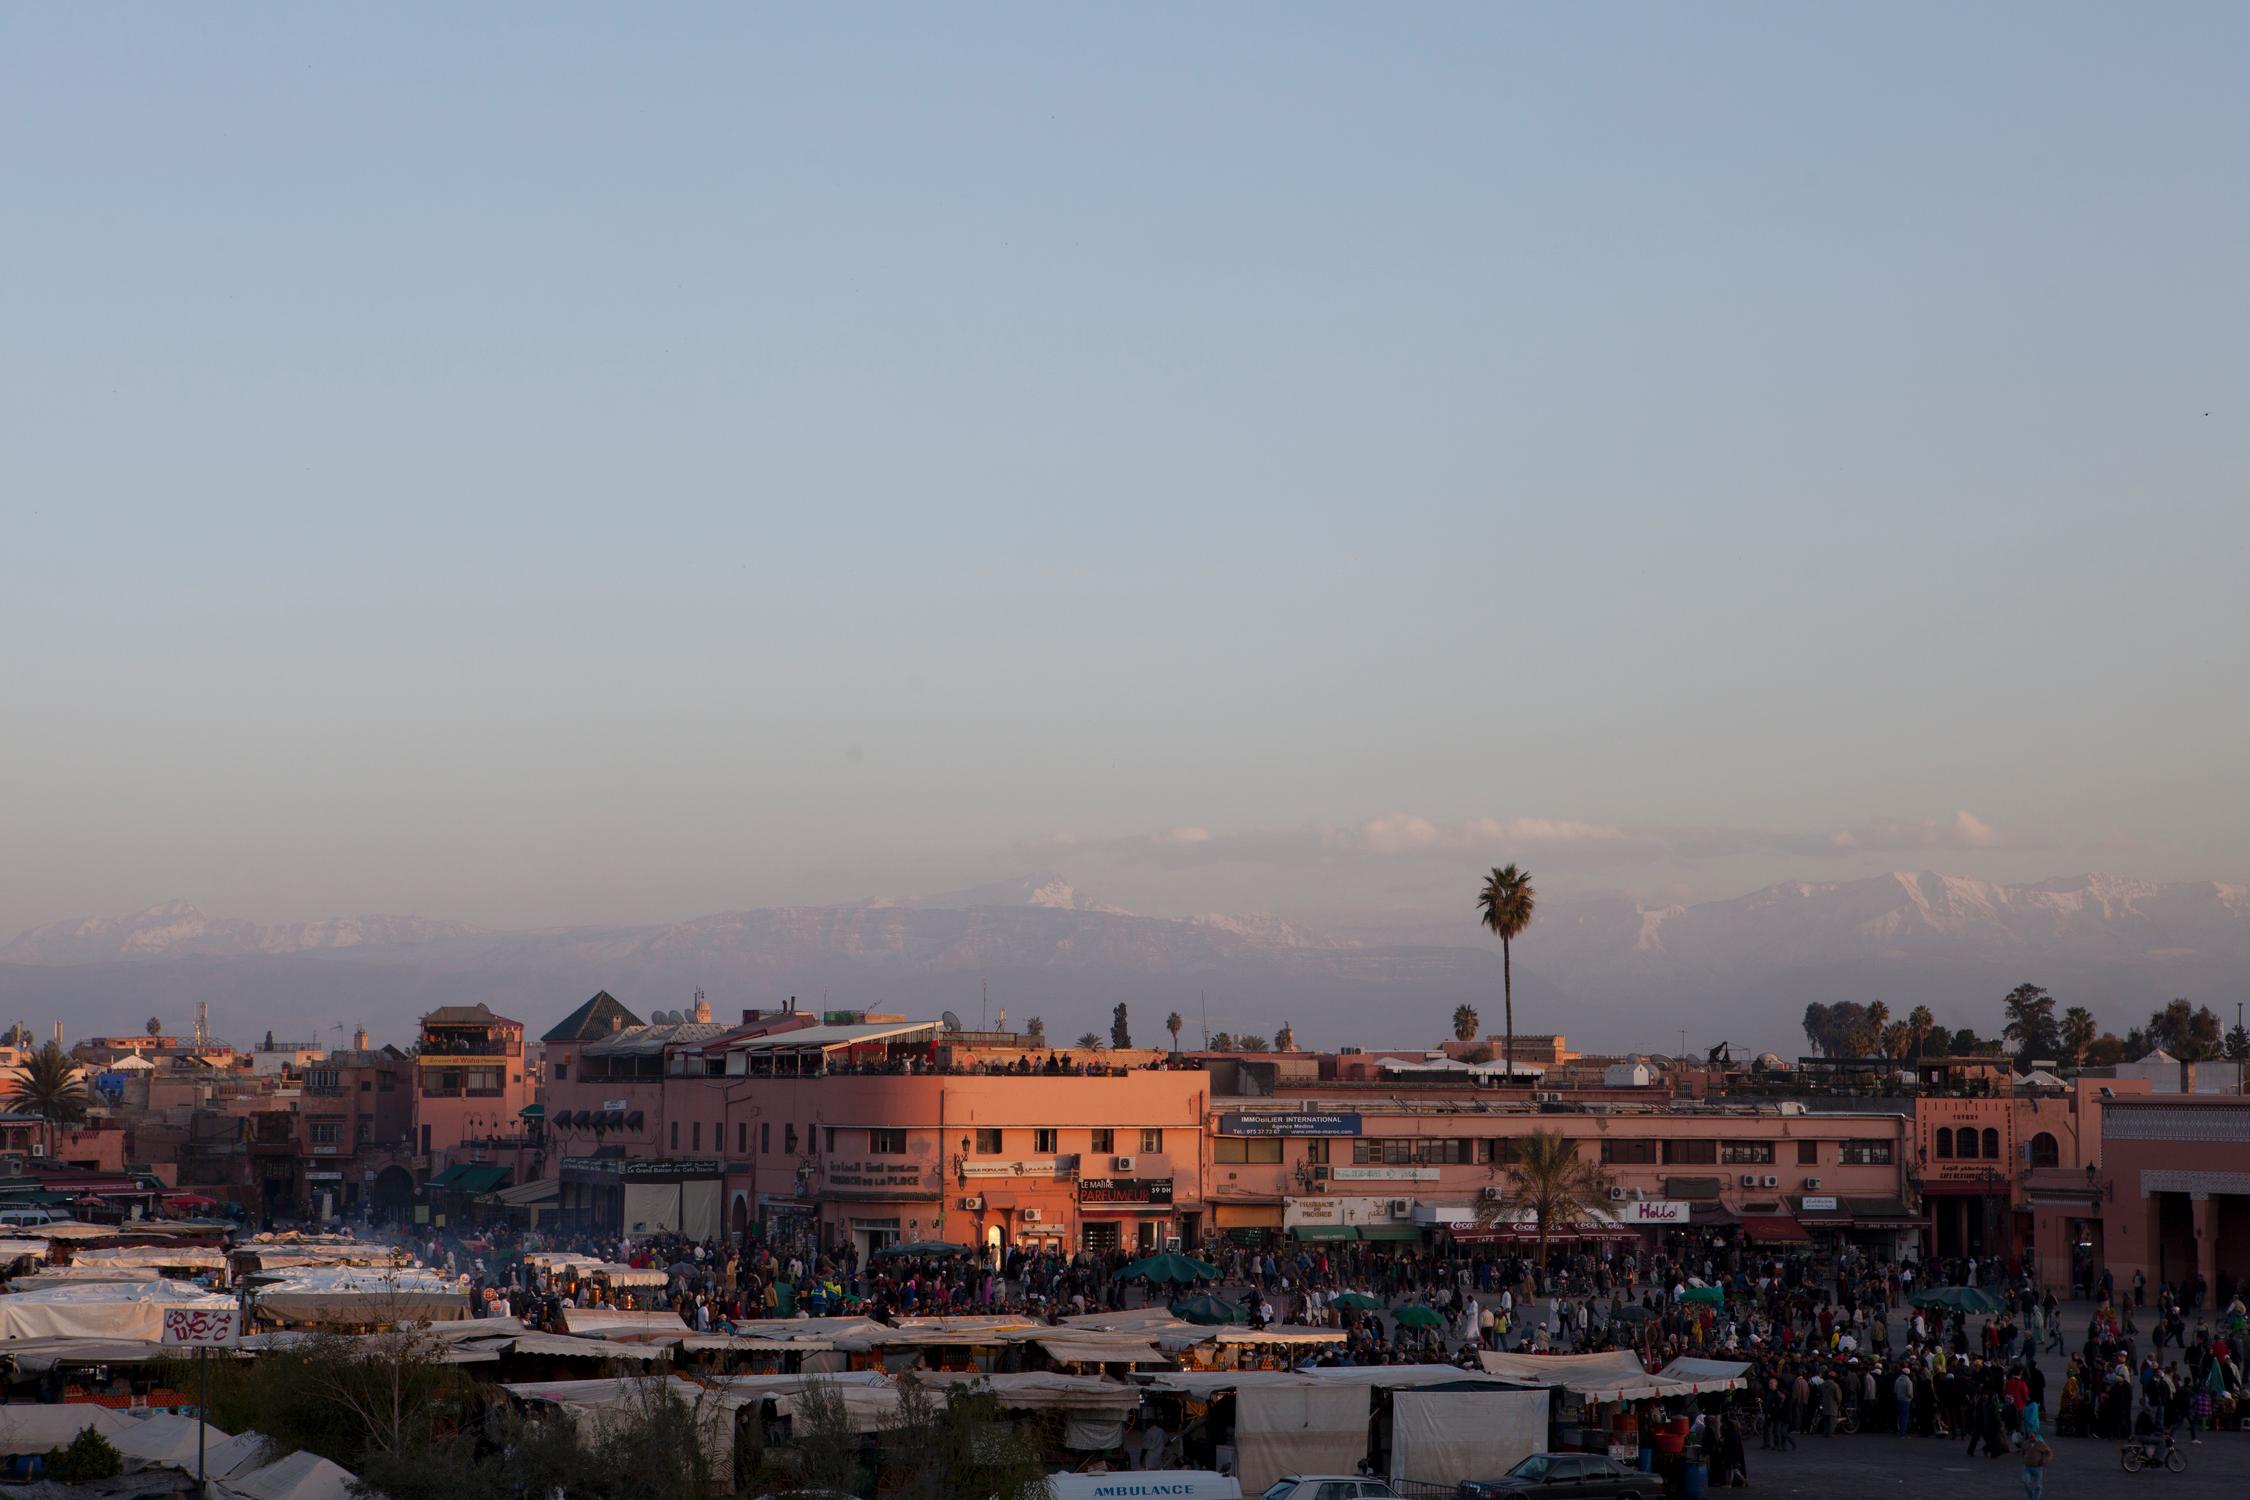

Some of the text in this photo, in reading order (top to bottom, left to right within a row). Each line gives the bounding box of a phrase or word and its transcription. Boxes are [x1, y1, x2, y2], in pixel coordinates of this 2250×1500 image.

[1081, 1181, 1089, 1189] LE
[1081, 1188, 1149, 1201] PARFUMEUR
[1094, 1485, 1194, 1497] AMBULANCE
